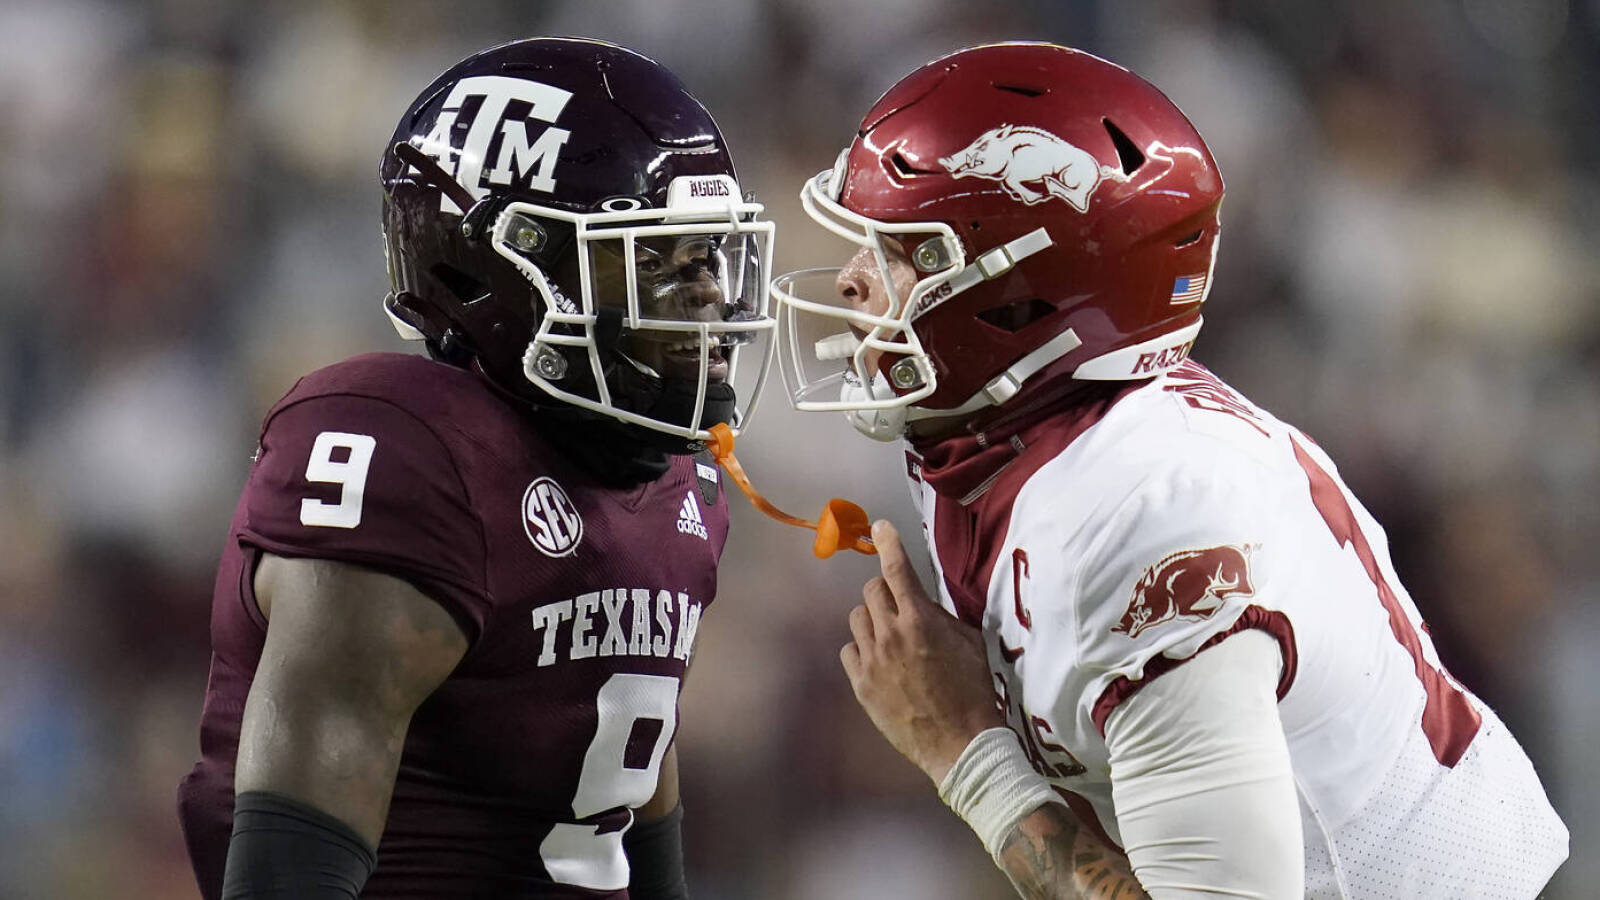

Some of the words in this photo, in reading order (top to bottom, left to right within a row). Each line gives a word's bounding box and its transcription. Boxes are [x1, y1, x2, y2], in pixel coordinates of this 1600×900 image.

[690, 180, 730, 197] AGGIES
[300, 432, 377, 529] 9
[526, 482, 580, 552] SEC
[677, 519, 708, 541] adidas
[532, 588, 673, 667] TEXAS
[539, 673, 680, 891] 9
